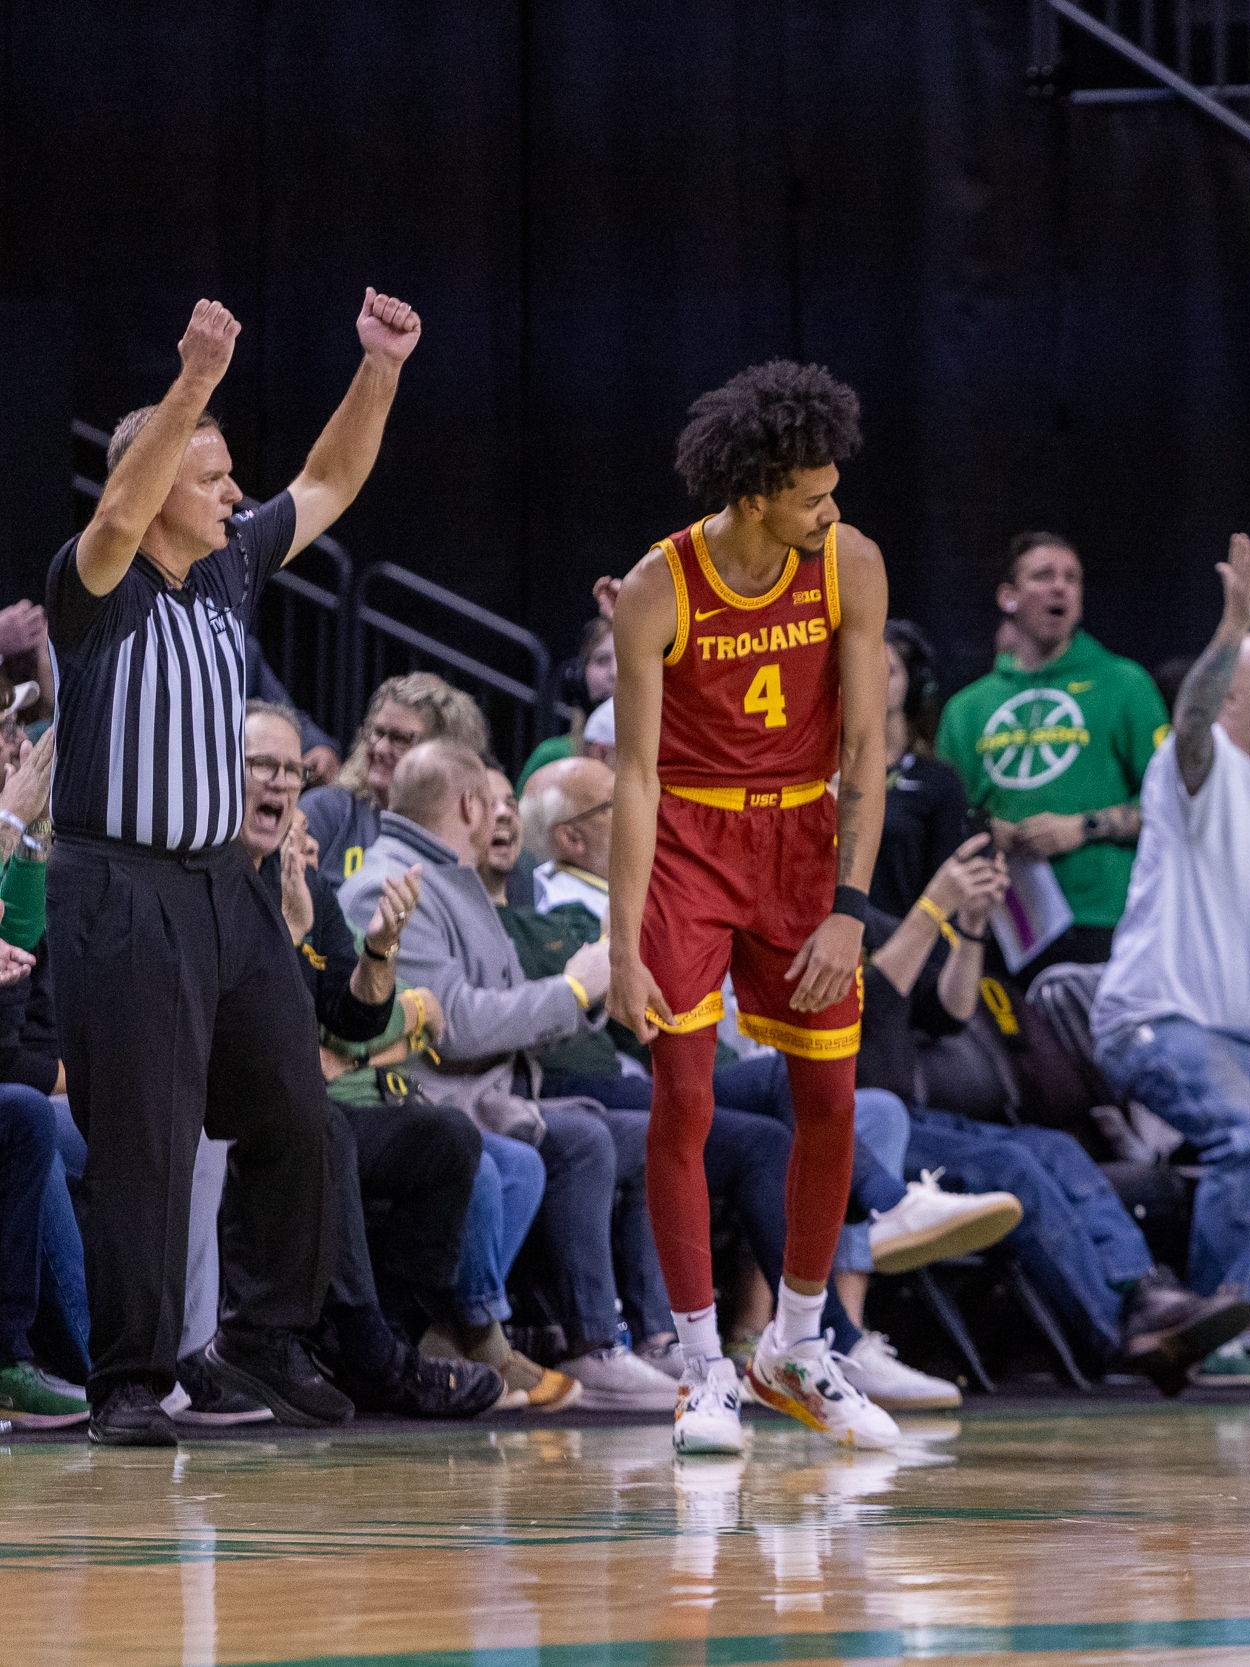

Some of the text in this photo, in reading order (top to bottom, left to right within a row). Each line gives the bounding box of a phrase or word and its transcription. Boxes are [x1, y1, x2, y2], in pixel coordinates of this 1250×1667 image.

[697, 617, 828, 660] TROJANS
[743, 663, 787, 729] 4
[750, 793, 778, 808] USC
